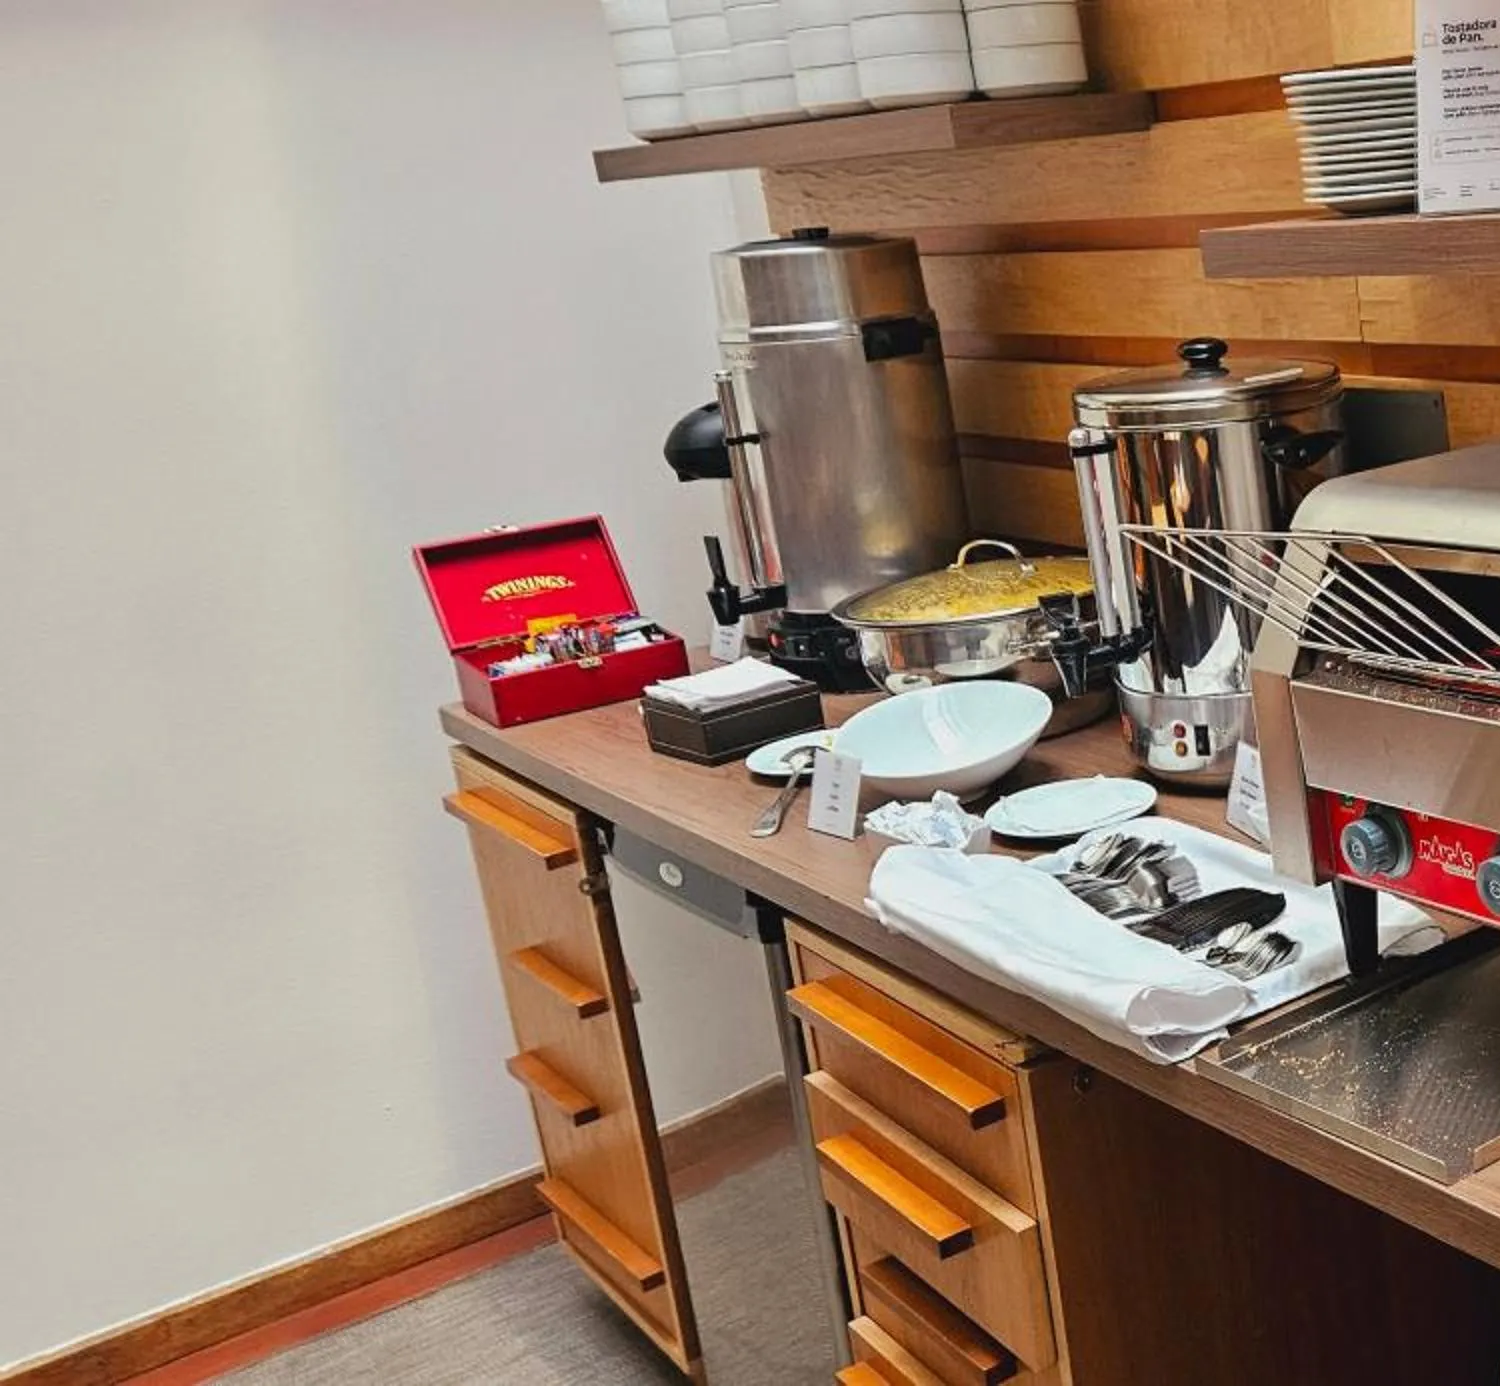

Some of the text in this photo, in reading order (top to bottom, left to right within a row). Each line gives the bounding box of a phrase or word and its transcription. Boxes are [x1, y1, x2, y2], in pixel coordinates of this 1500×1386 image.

[1442, 19, 1497, 33] Tostadora
[1442, 32, 1484, 45] de Pan.
[485, 575, 567, 601] TWININGS
